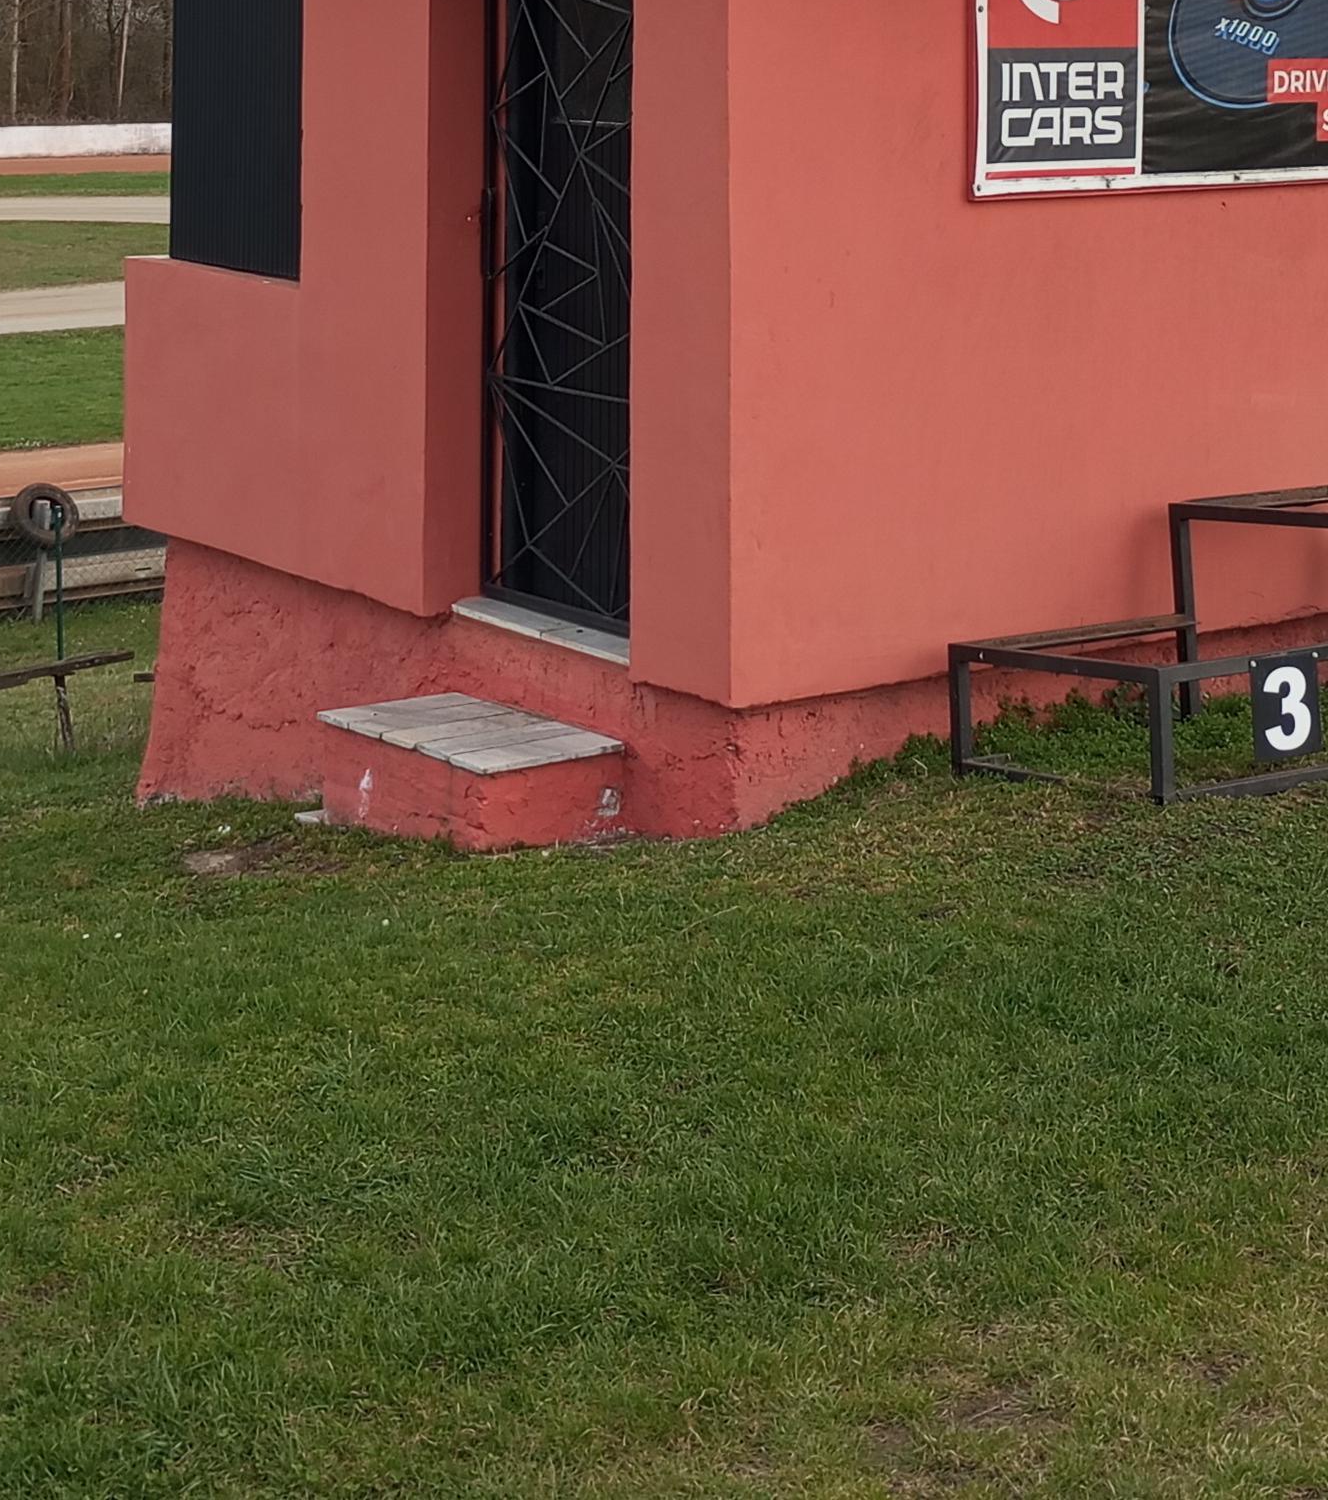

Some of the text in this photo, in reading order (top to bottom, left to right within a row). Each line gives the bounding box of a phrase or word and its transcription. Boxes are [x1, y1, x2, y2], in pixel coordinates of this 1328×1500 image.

[1001, 60, 1125, 102] INTER
[1000, 105, 1124, 148] CARS
[1262, 665, 1313, 752] 3
